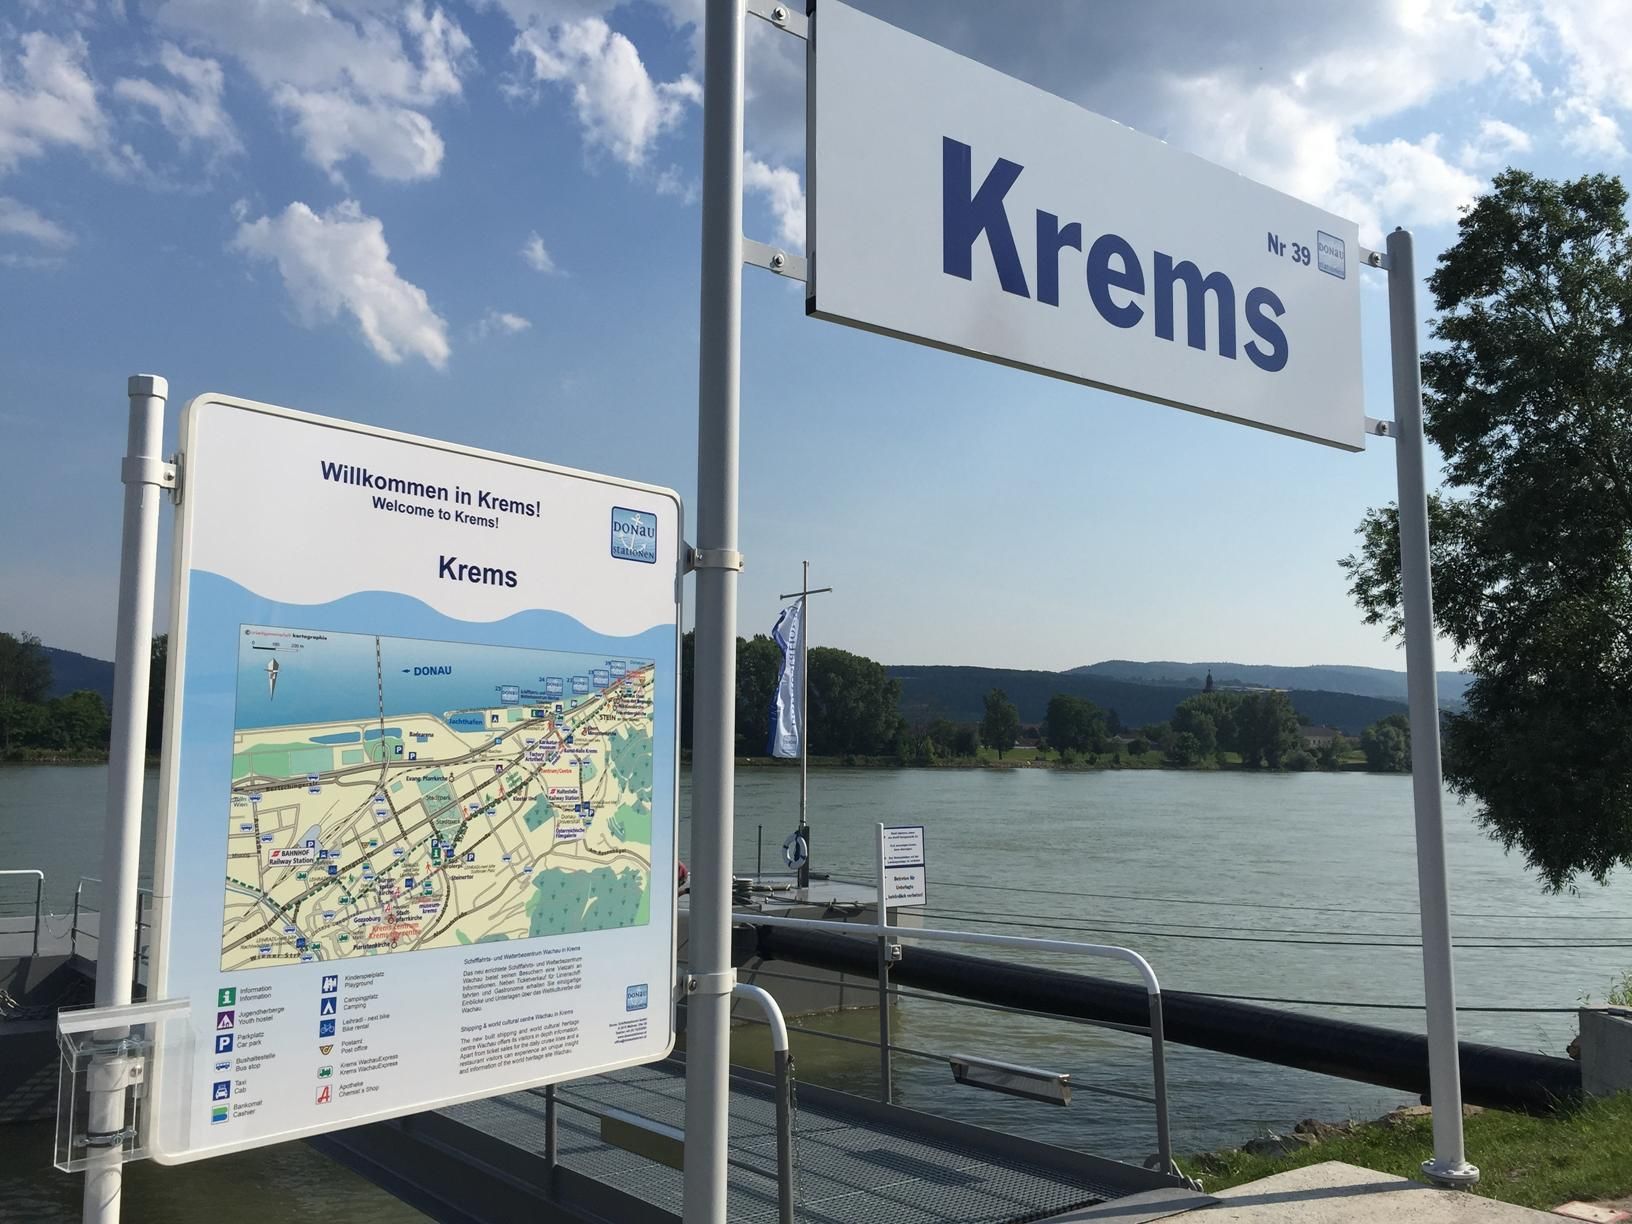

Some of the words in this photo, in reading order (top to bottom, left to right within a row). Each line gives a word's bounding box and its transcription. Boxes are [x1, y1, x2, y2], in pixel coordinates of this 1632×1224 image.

[942, 135, 1289, 372] Krems
[1268, 232, 1286, 256] Nr
[1292, 242, 1311, 266] 39
[321, 461, 448, 501] Willkommen
[456, 486, 471, 505] in
[478, 490, 541, 517] Krems!
[372, 496, 434, 517] Welcome
[438, 508, 451, 520] to
[455, 510, 499, 528] Krems!
[439, 555, 518, 588] Krems
[414, 666, 452, 676] DONAU
[281, 849, 310, 857] BAHNHOF
[270, 857, 292, 866] Railway
[293, 856, 314, 864] Station
[345, 980, 373, 988] Playground
[344, 995, 379, 1003] Campingplatz
[239, 1007, 285, 1018] Jugendherberge
[237, 1032, 264, 1040] Parkplatz
[339, 1082, 364, 1090] Apotheke
[234, 1100, 263, 1110] Bankomat
